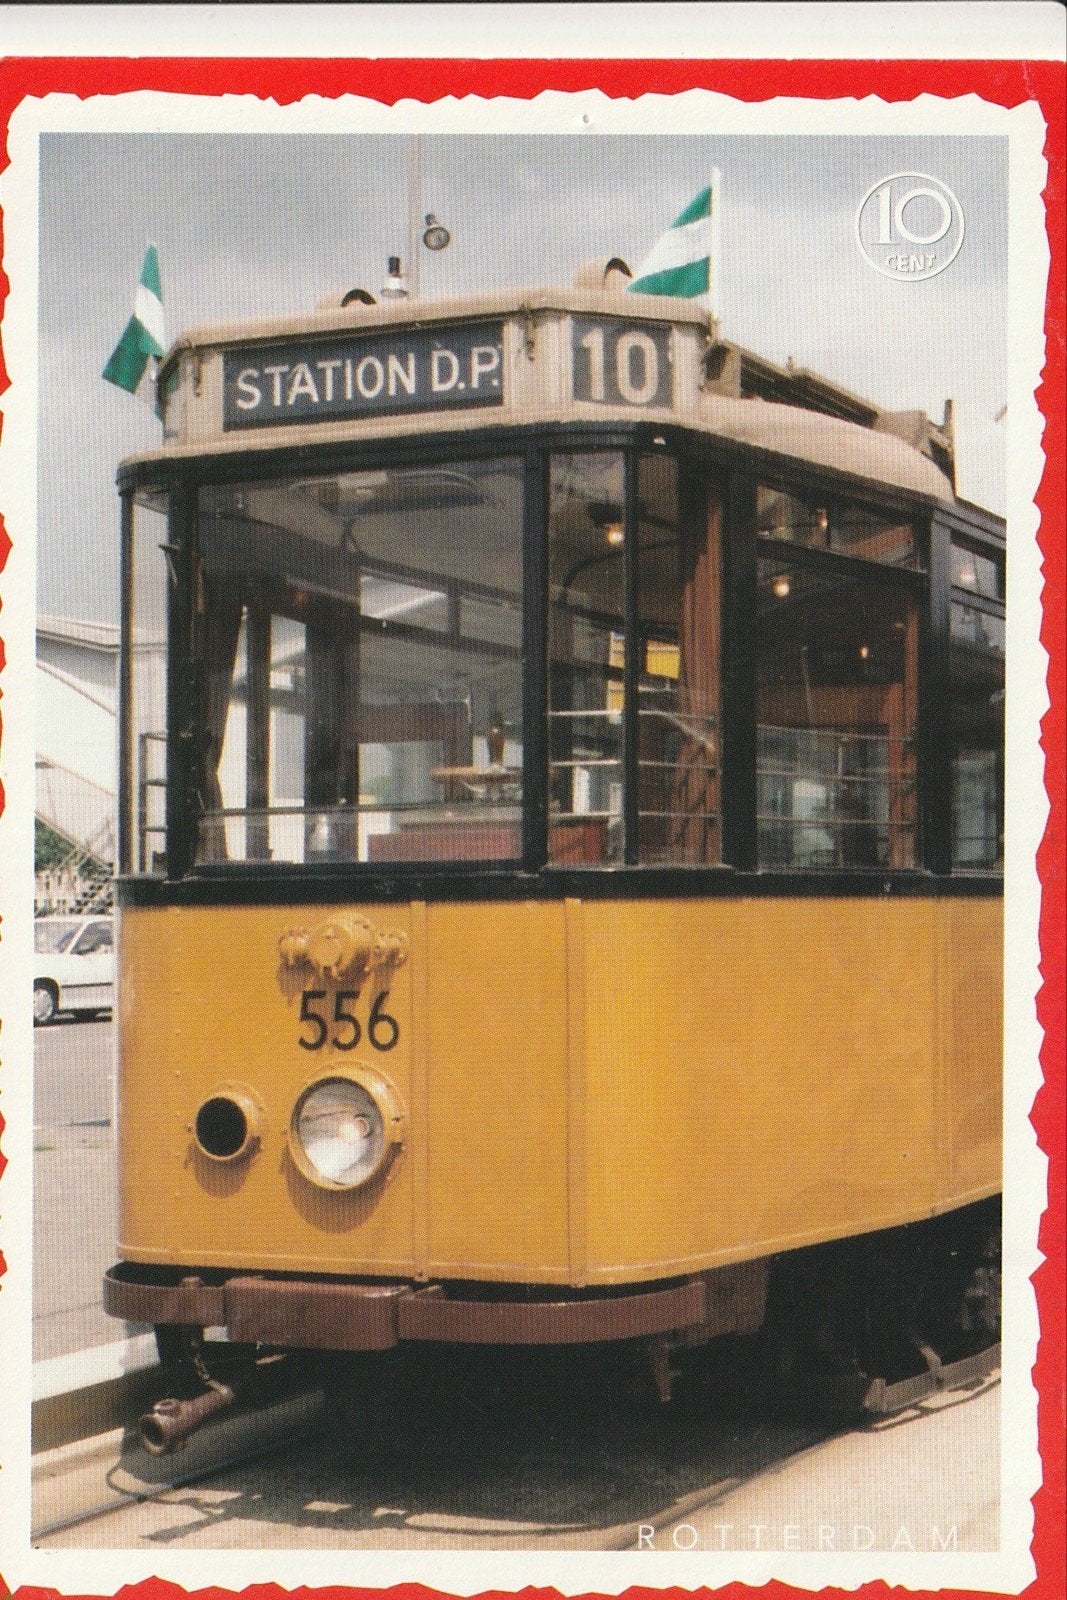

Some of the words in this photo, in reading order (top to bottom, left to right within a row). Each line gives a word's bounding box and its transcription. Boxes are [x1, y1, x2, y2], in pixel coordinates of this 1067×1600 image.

[236, 352, 416, 411] STATION
[431, 346, 501, 393] D.P.
[581, 330, 660, 404] 10
[299, 990, 399, 1051] 556
